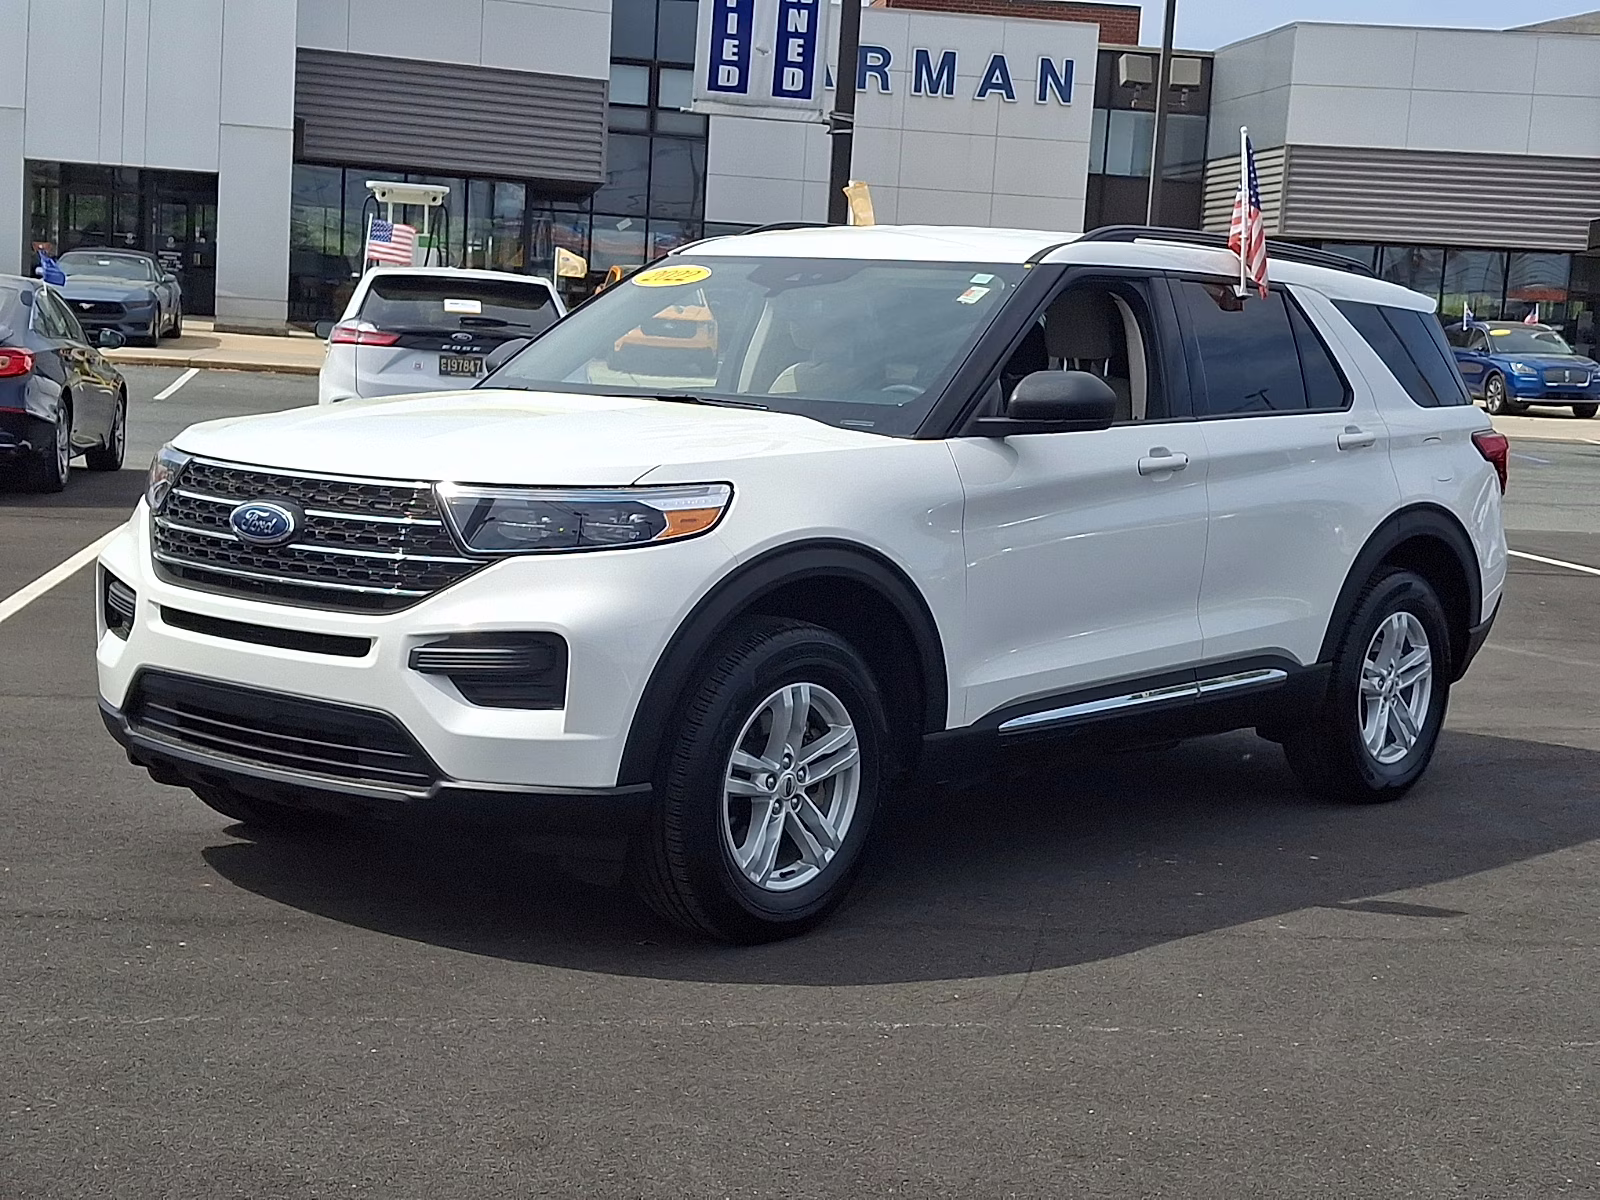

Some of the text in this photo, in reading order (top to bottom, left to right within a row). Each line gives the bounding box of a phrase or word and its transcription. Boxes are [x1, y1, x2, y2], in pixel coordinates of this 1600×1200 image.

[717, 0, 740, 87] IED
[782, 0, 809, 91] NED
[824, 43, 1075, 106] RMAN
[241, 509, 278, 534] Ford
